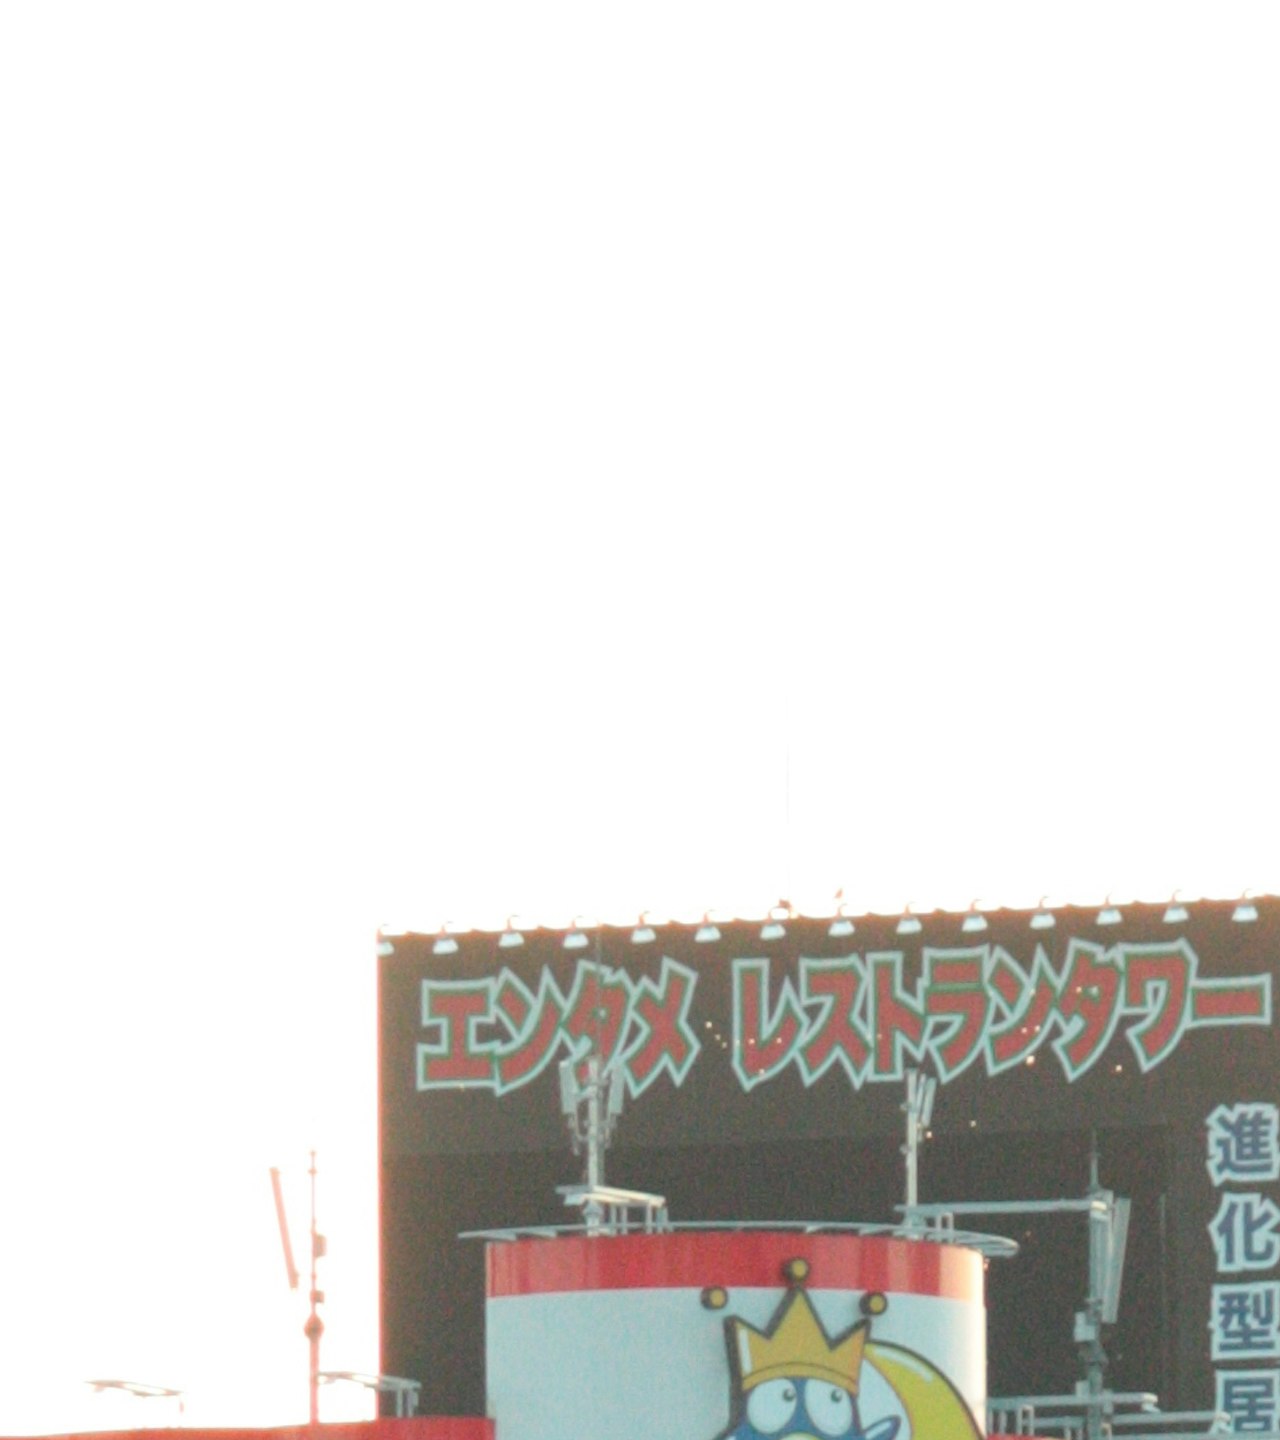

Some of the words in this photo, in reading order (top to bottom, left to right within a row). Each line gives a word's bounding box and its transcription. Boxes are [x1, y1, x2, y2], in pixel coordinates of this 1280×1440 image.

[417, 955, 701, 1098] エンタメ
[731, 938, 1273, 1092] レストランタワー
